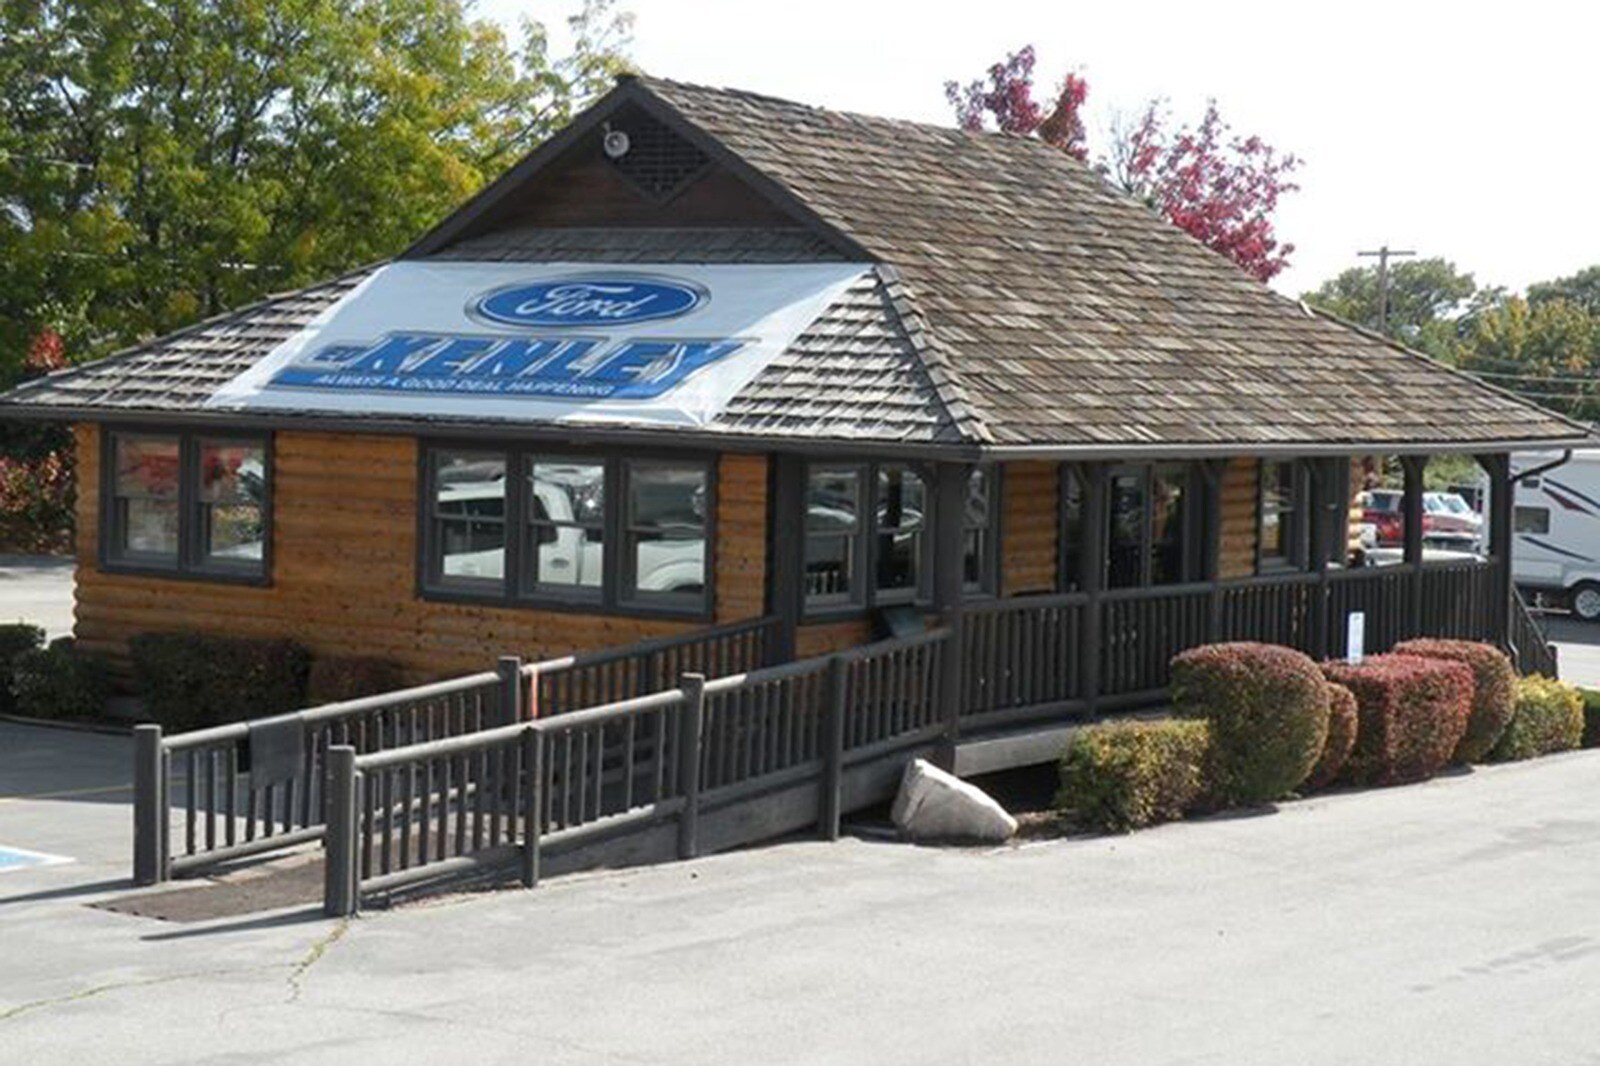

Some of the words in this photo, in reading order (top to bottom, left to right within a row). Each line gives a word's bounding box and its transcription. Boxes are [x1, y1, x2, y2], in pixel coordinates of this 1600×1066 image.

[515, 283, 658, 318] Ford
[348, 335, 744, 381] KENLEY
[312, 374, 382, 387] ALWAYS
[401, 377, 456, 389] GOOD
[453, 378, 504, 391] DEAL
[505, 380, 615, 396] HAPPENING
